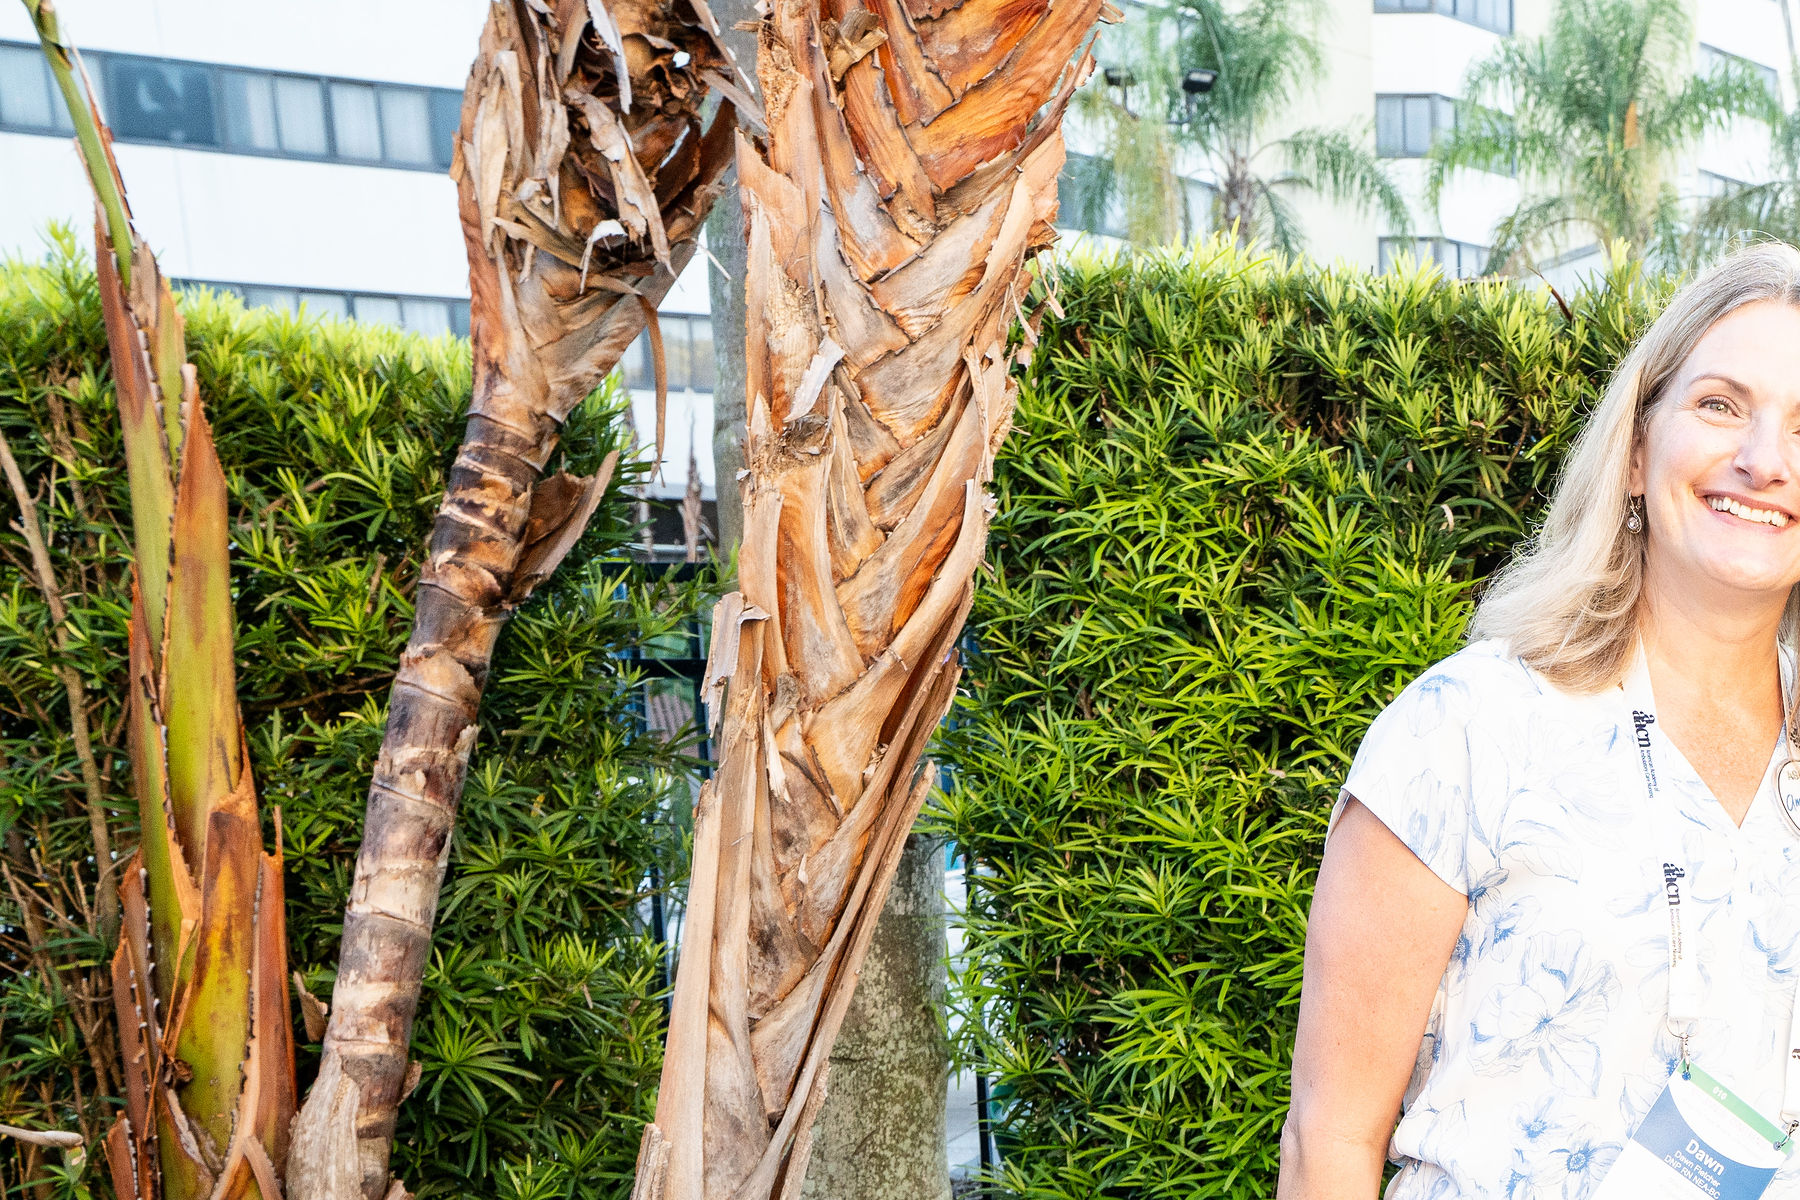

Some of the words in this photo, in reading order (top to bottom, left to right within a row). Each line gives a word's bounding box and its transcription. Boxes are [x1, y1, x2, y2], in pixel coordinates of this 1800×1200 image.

[1675, 1150, 1694, 1168] Dawn
[1694, 1164, 1720, 1187] Fletcher
[1685, 1139, 1724, 1176] Dawn
[1664, 1154, 1681, 1169] DNP
[1680, 1166, 1693, 1179] RN
[1692, 1175, 1720, 1199] NEA-BC
